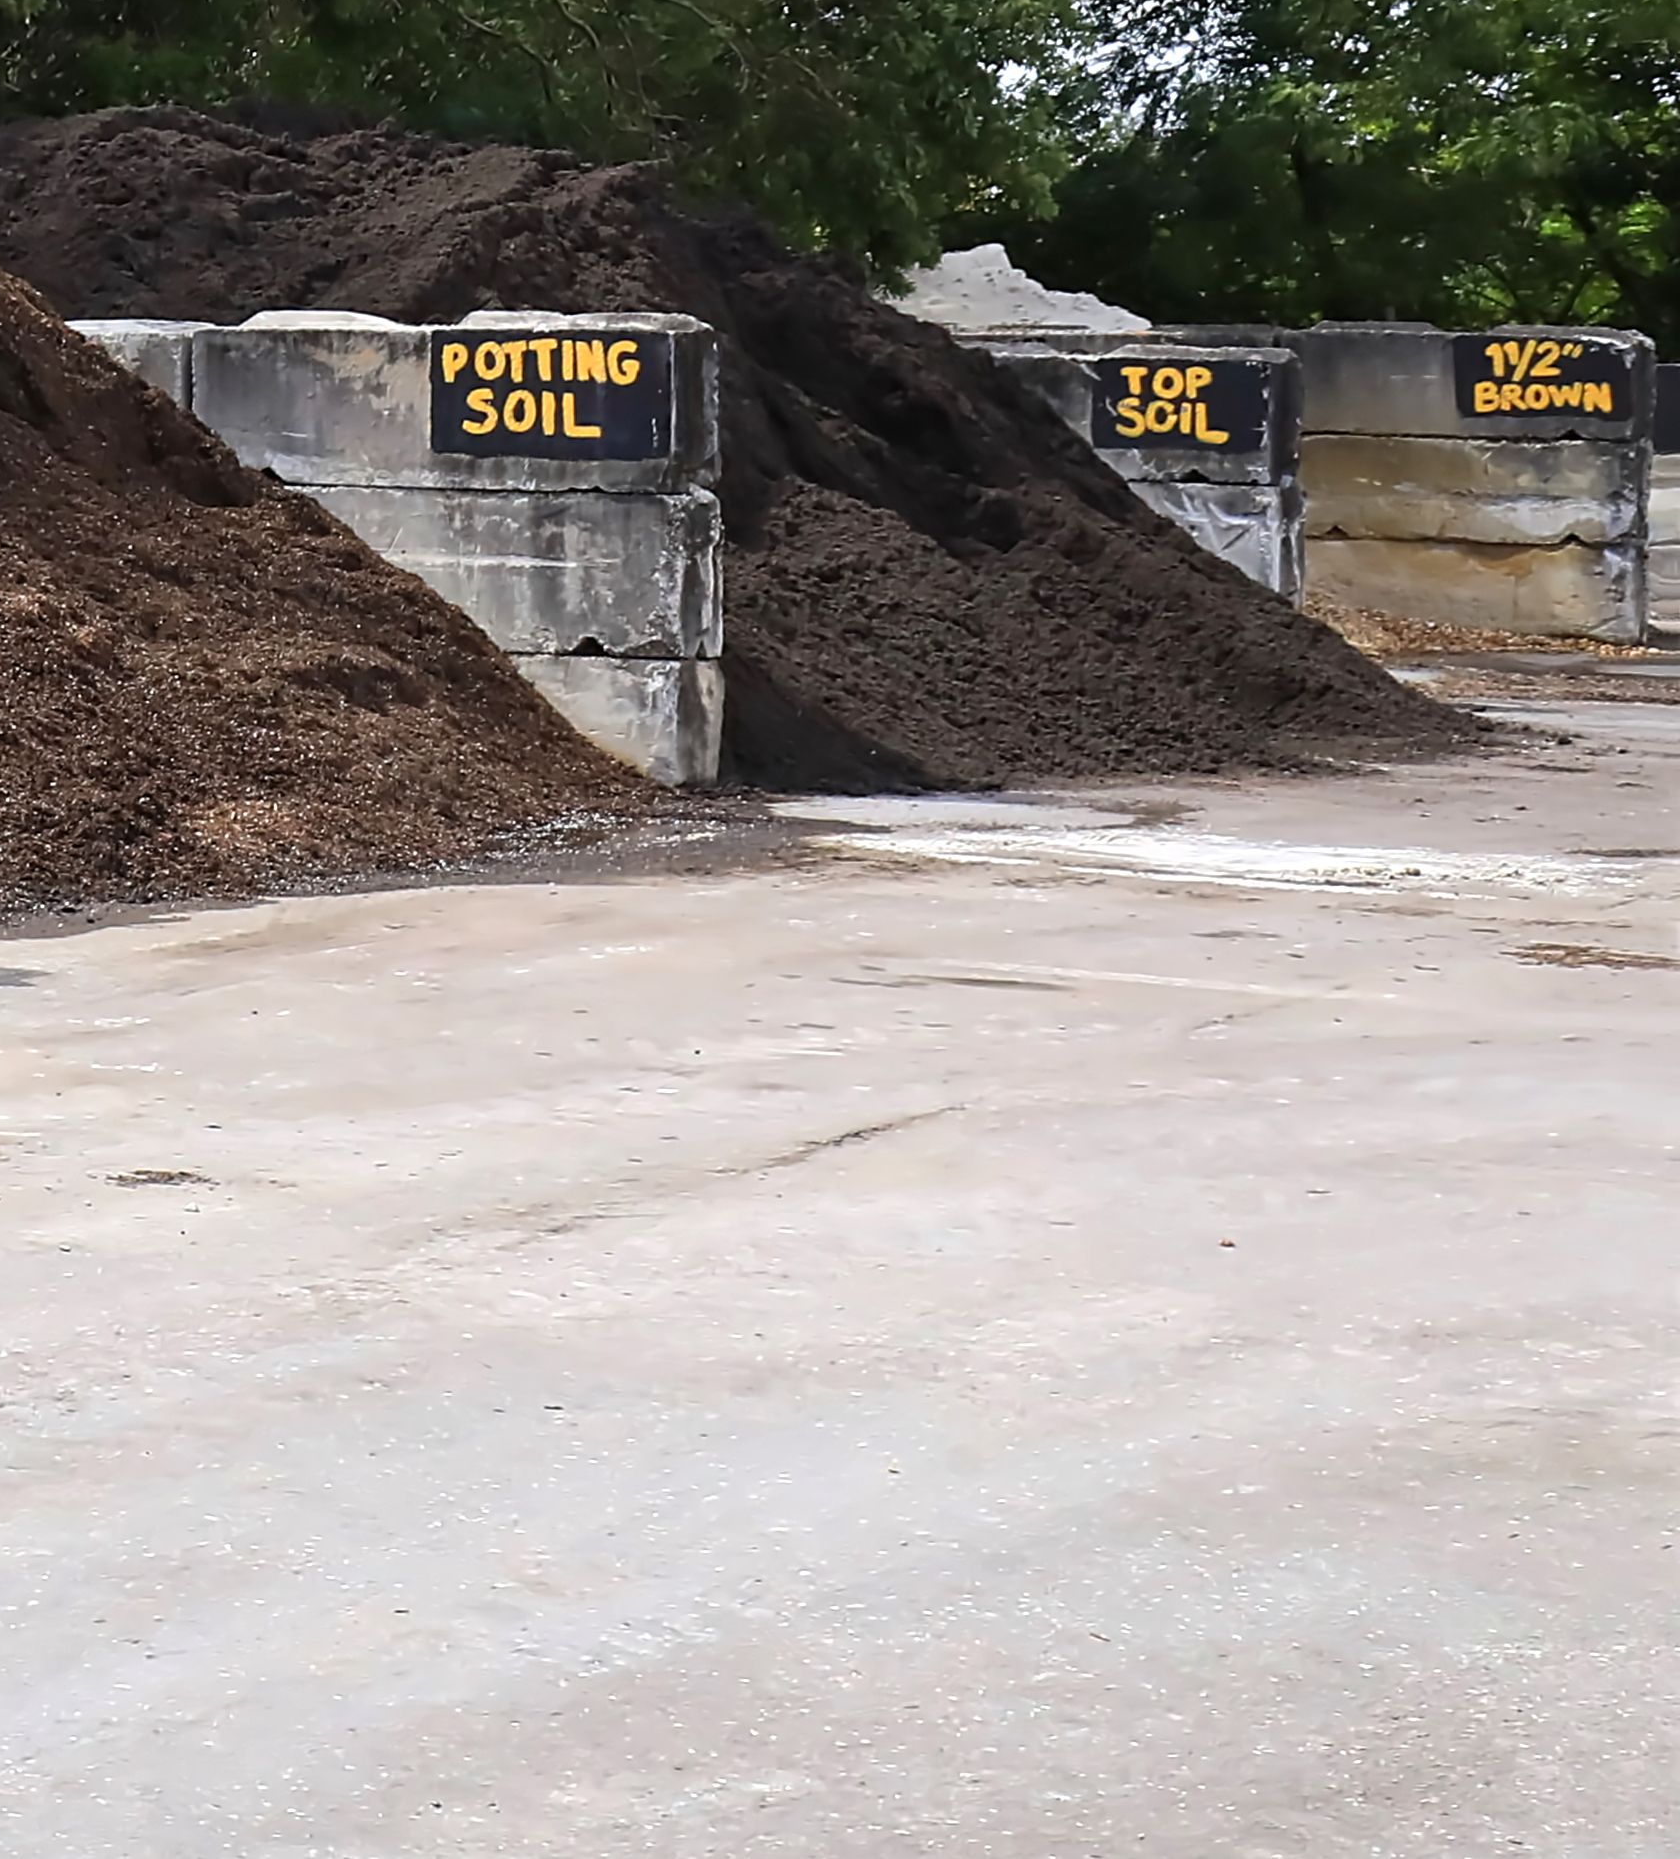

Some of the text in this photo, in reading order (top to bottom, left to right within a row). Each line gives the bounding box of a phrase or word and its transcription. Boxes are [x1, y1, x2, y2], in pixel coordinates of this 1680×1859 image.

[442, 338, 641, 386] POTTING
[1120, 366, 1213, 400] TOP
[462, 387, 603, 438] SOIL
[1115, 396, 1231, 444] SOIL
[1473, 380, 1613, 413] BROWN
